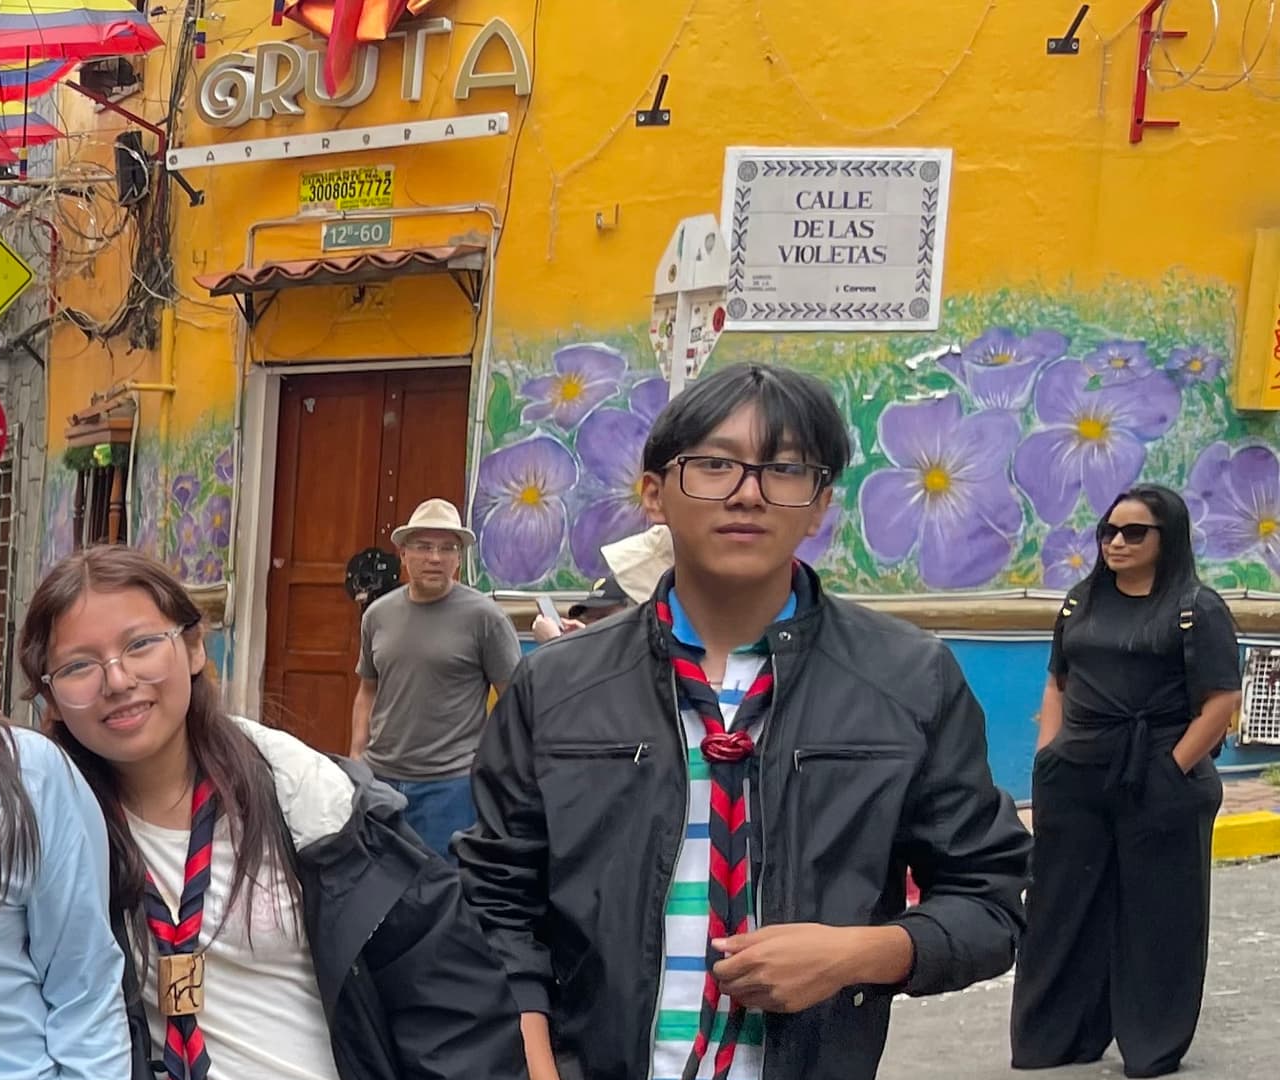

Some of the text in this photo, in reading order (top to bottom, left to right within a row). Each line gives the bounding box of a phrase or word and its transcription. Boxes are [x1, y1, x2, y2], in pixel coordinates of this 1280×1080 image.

[309, 177, 391, 202] 3008057772
[795, 190, 873, 210] CALLE
[793, 219, 875, 239] DE LAS
[778, 245, 888, 264] VIOLETAS
